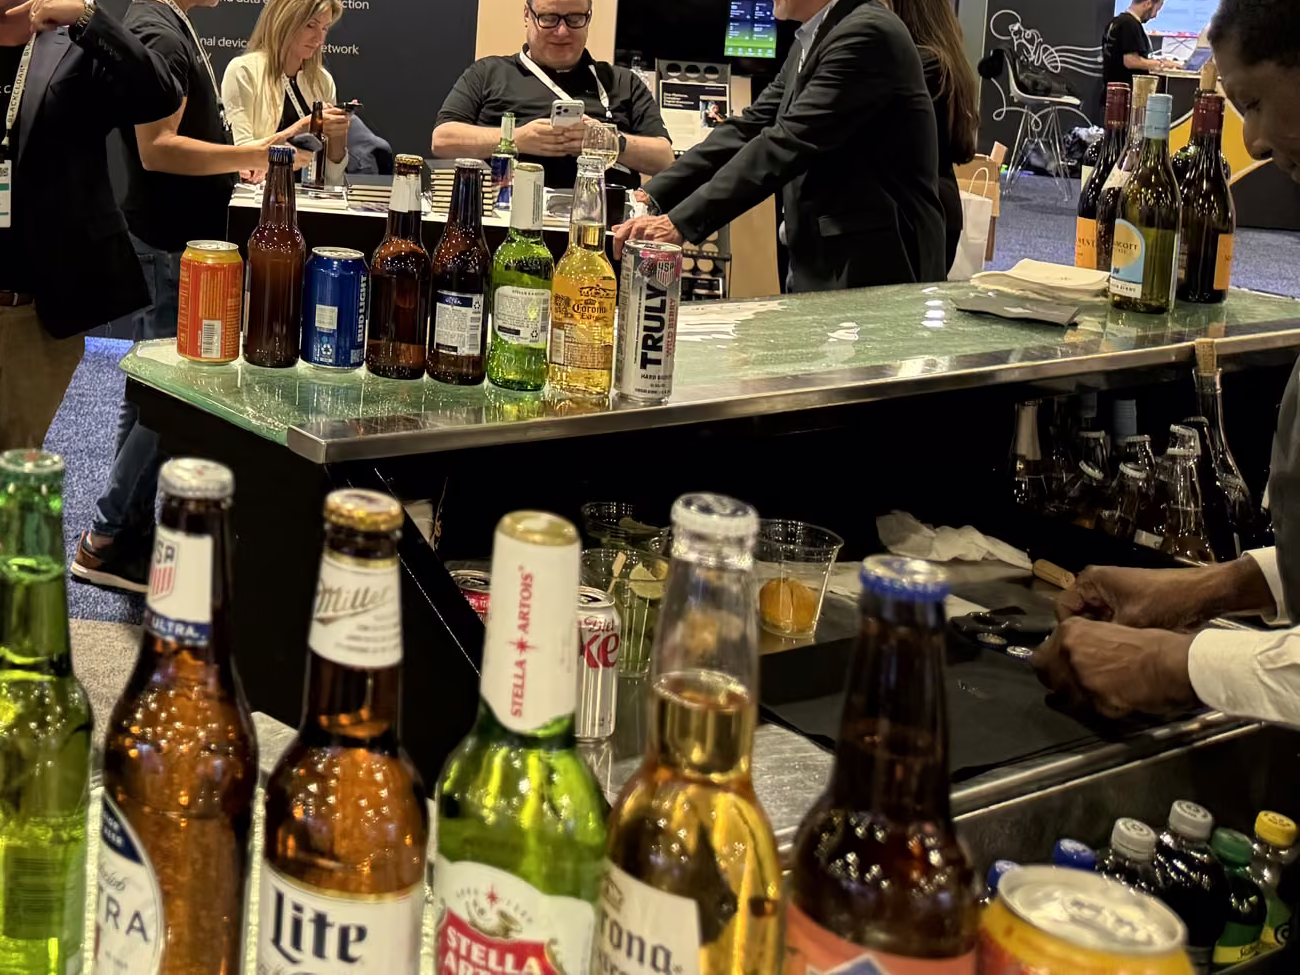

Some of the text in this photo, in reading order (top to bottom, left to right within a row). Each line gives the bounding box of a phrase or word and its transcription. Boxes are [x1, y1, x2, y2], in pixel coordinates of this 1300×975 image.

[218, 37, 248, 48] devic
[321, 43, 359, 55] etwork
[640, 283, 669, 370] TRULY
[511, 659, 526, 718] STELLA
[270, 888, 368, 965] Lite
[446, 925, 543, 975] STELLA
